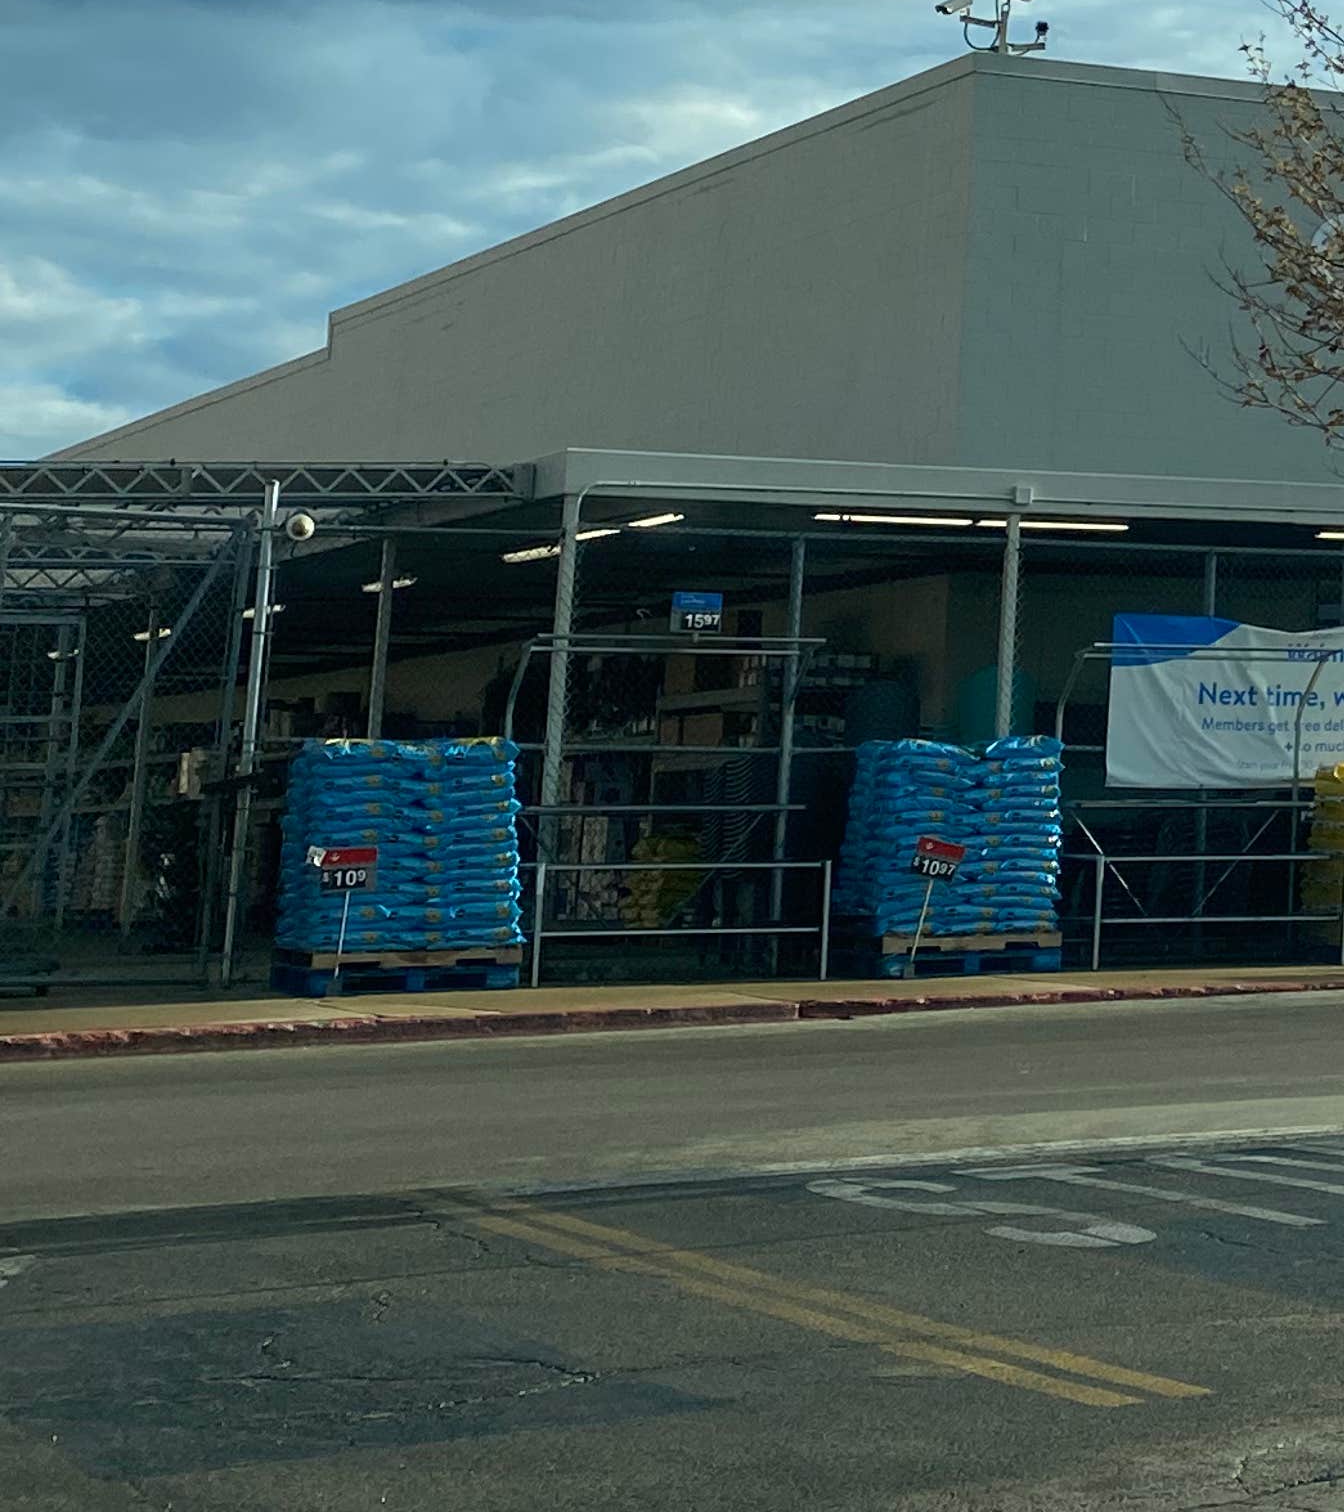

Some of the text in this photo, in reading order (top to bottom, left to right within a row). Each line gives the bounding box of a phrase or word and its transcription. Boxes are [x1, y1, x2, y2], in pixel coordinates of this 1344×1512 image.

[1198, 681, 1257, 706] Next
[1266, 684, 1325, 710] time,
[1201, 717, 1266, 731] Members
[1291, 718, 1320, 732] ree
